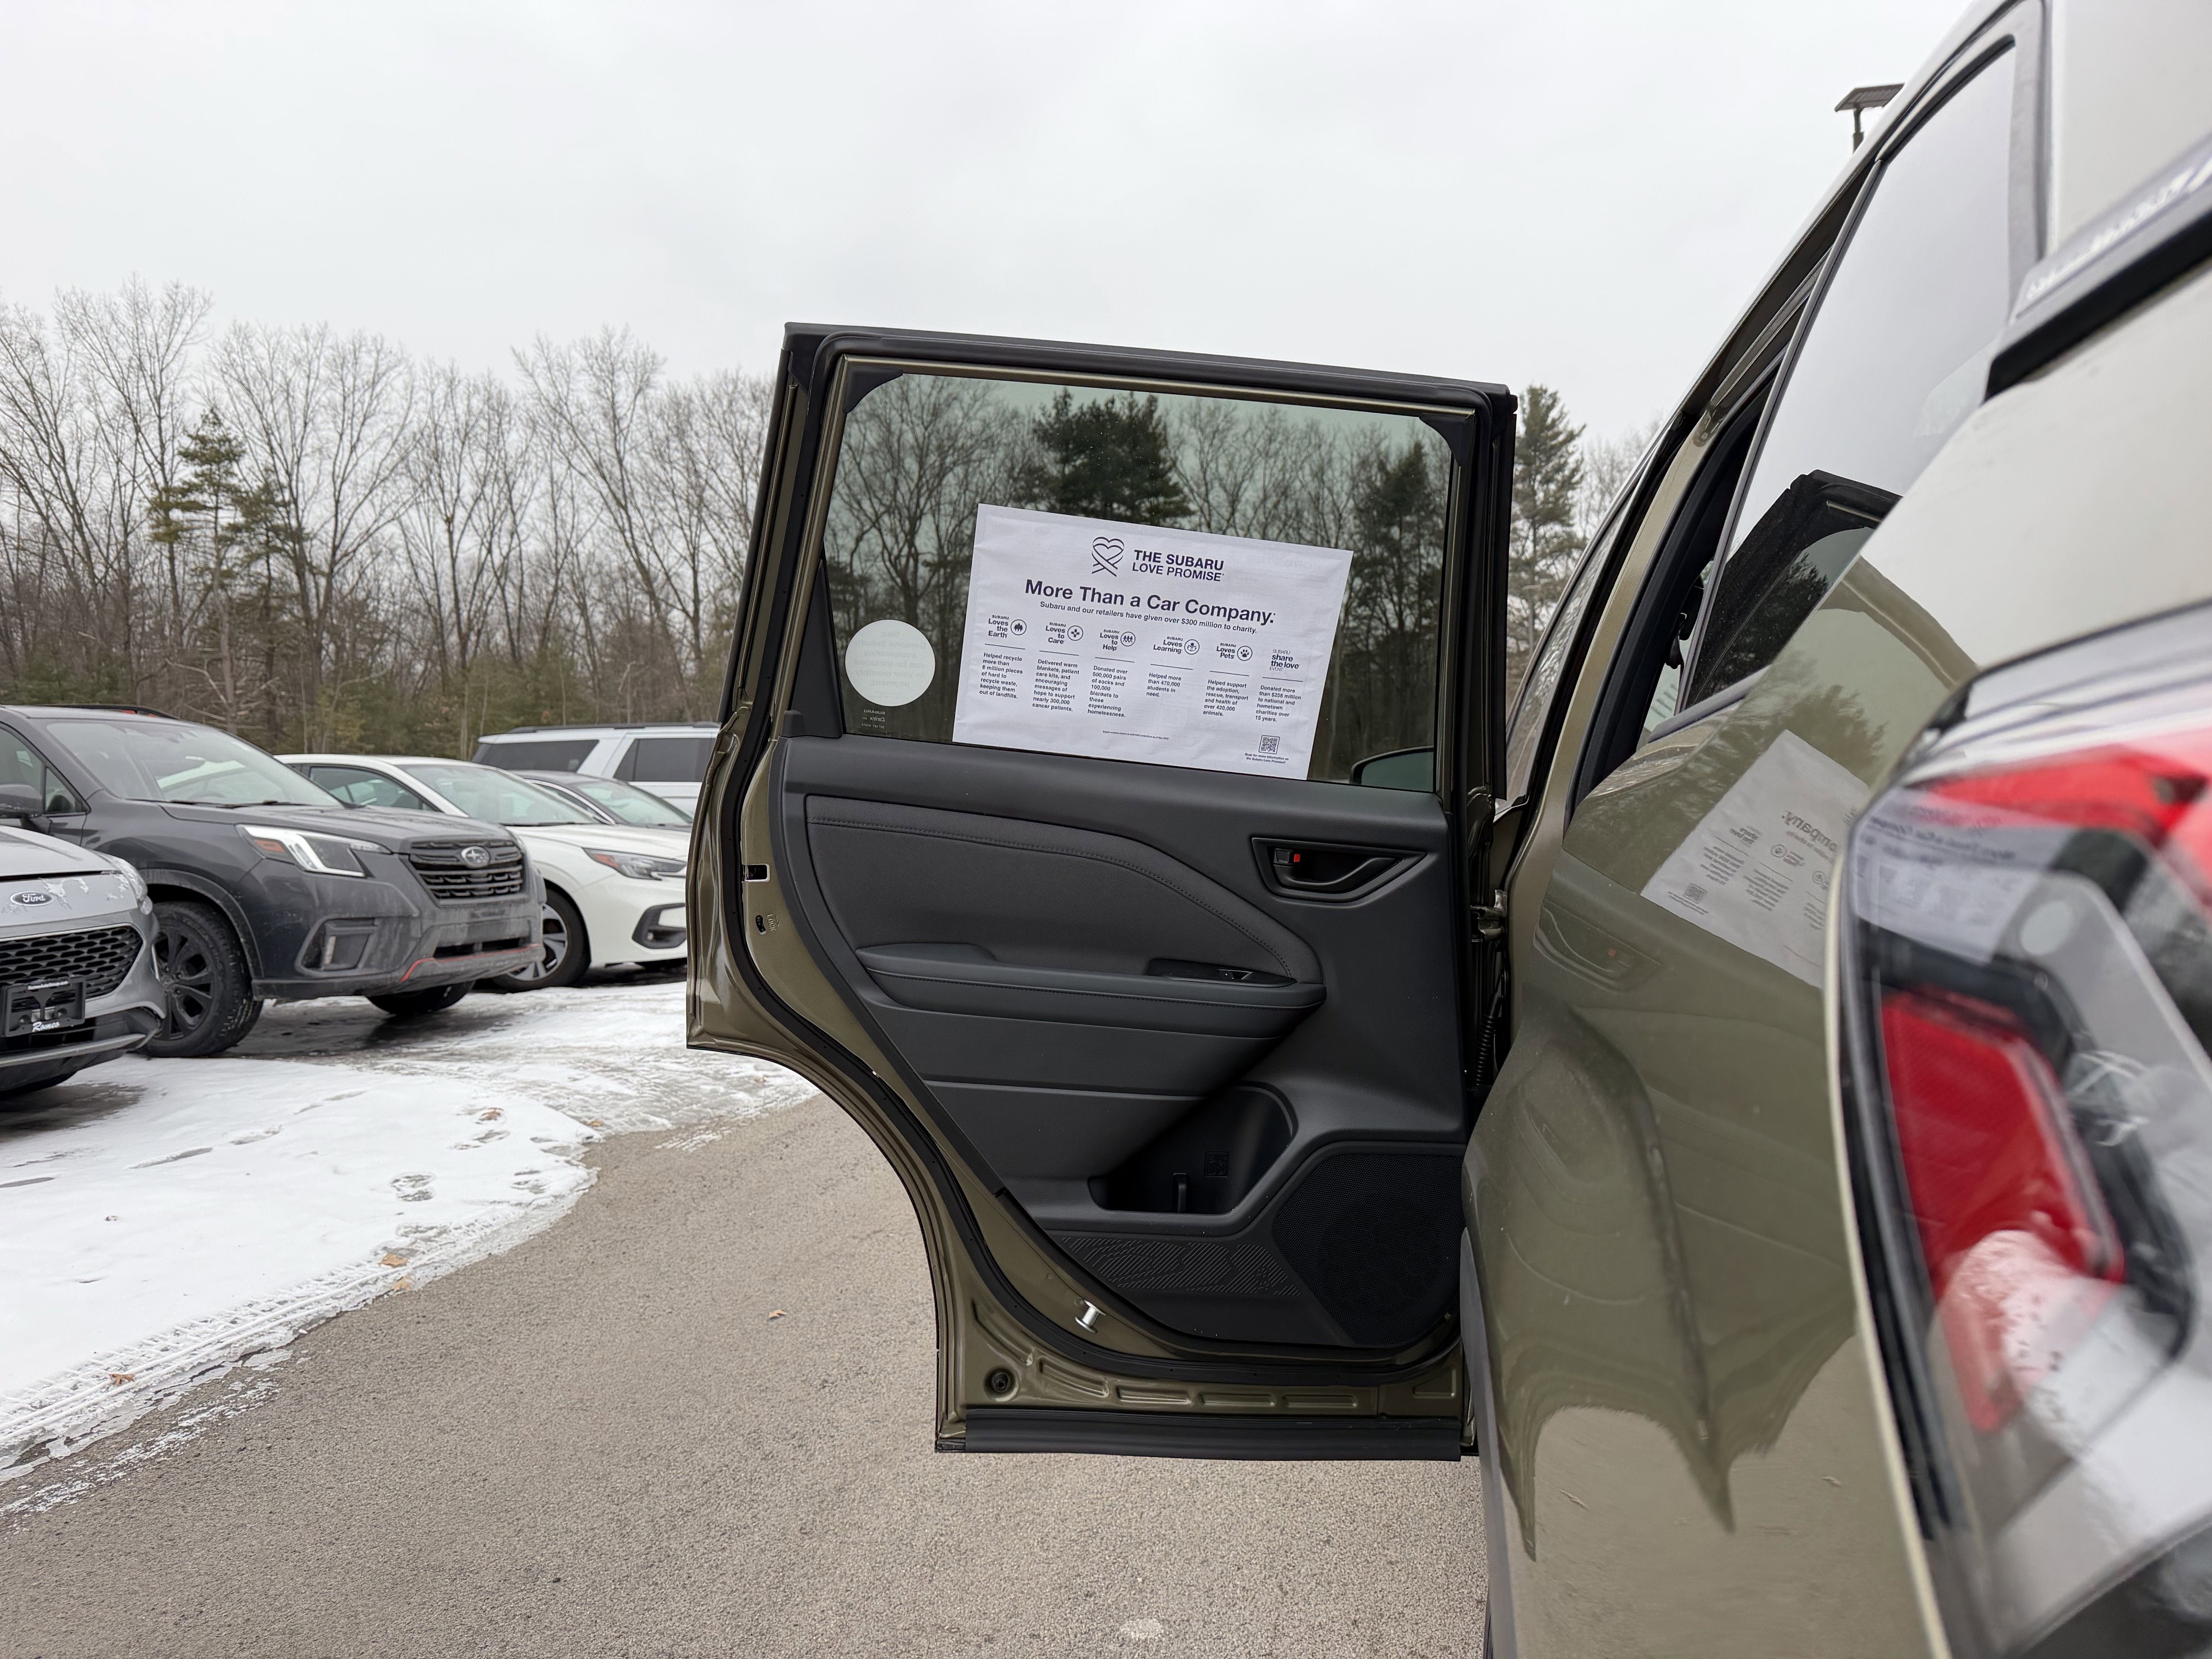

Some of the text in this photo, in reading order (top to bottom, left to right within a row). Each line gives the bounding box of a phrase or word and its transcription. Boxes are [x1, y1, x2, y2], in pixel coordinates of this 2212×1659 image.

[1134, 550, 1224, 571] THE SUBARU
[1132, 562, 1164, 575] LOVE
[1025, 579, 1073, 599] More
[1079, 586, 1124, 605] Than
[1130, 596, 1141, 608] a
[1147, 594, 1180, 611] Car
[1040, 601, 1065, 610] Subaru
[1233, 625, 1256, 634] charity.
[1153, 644, 1183, 654] Learning
[1088, 709, 1125, 717] homelessness.
[22, 893, 46, 903] Ford
[766, 914, 776, 931] LOCK
